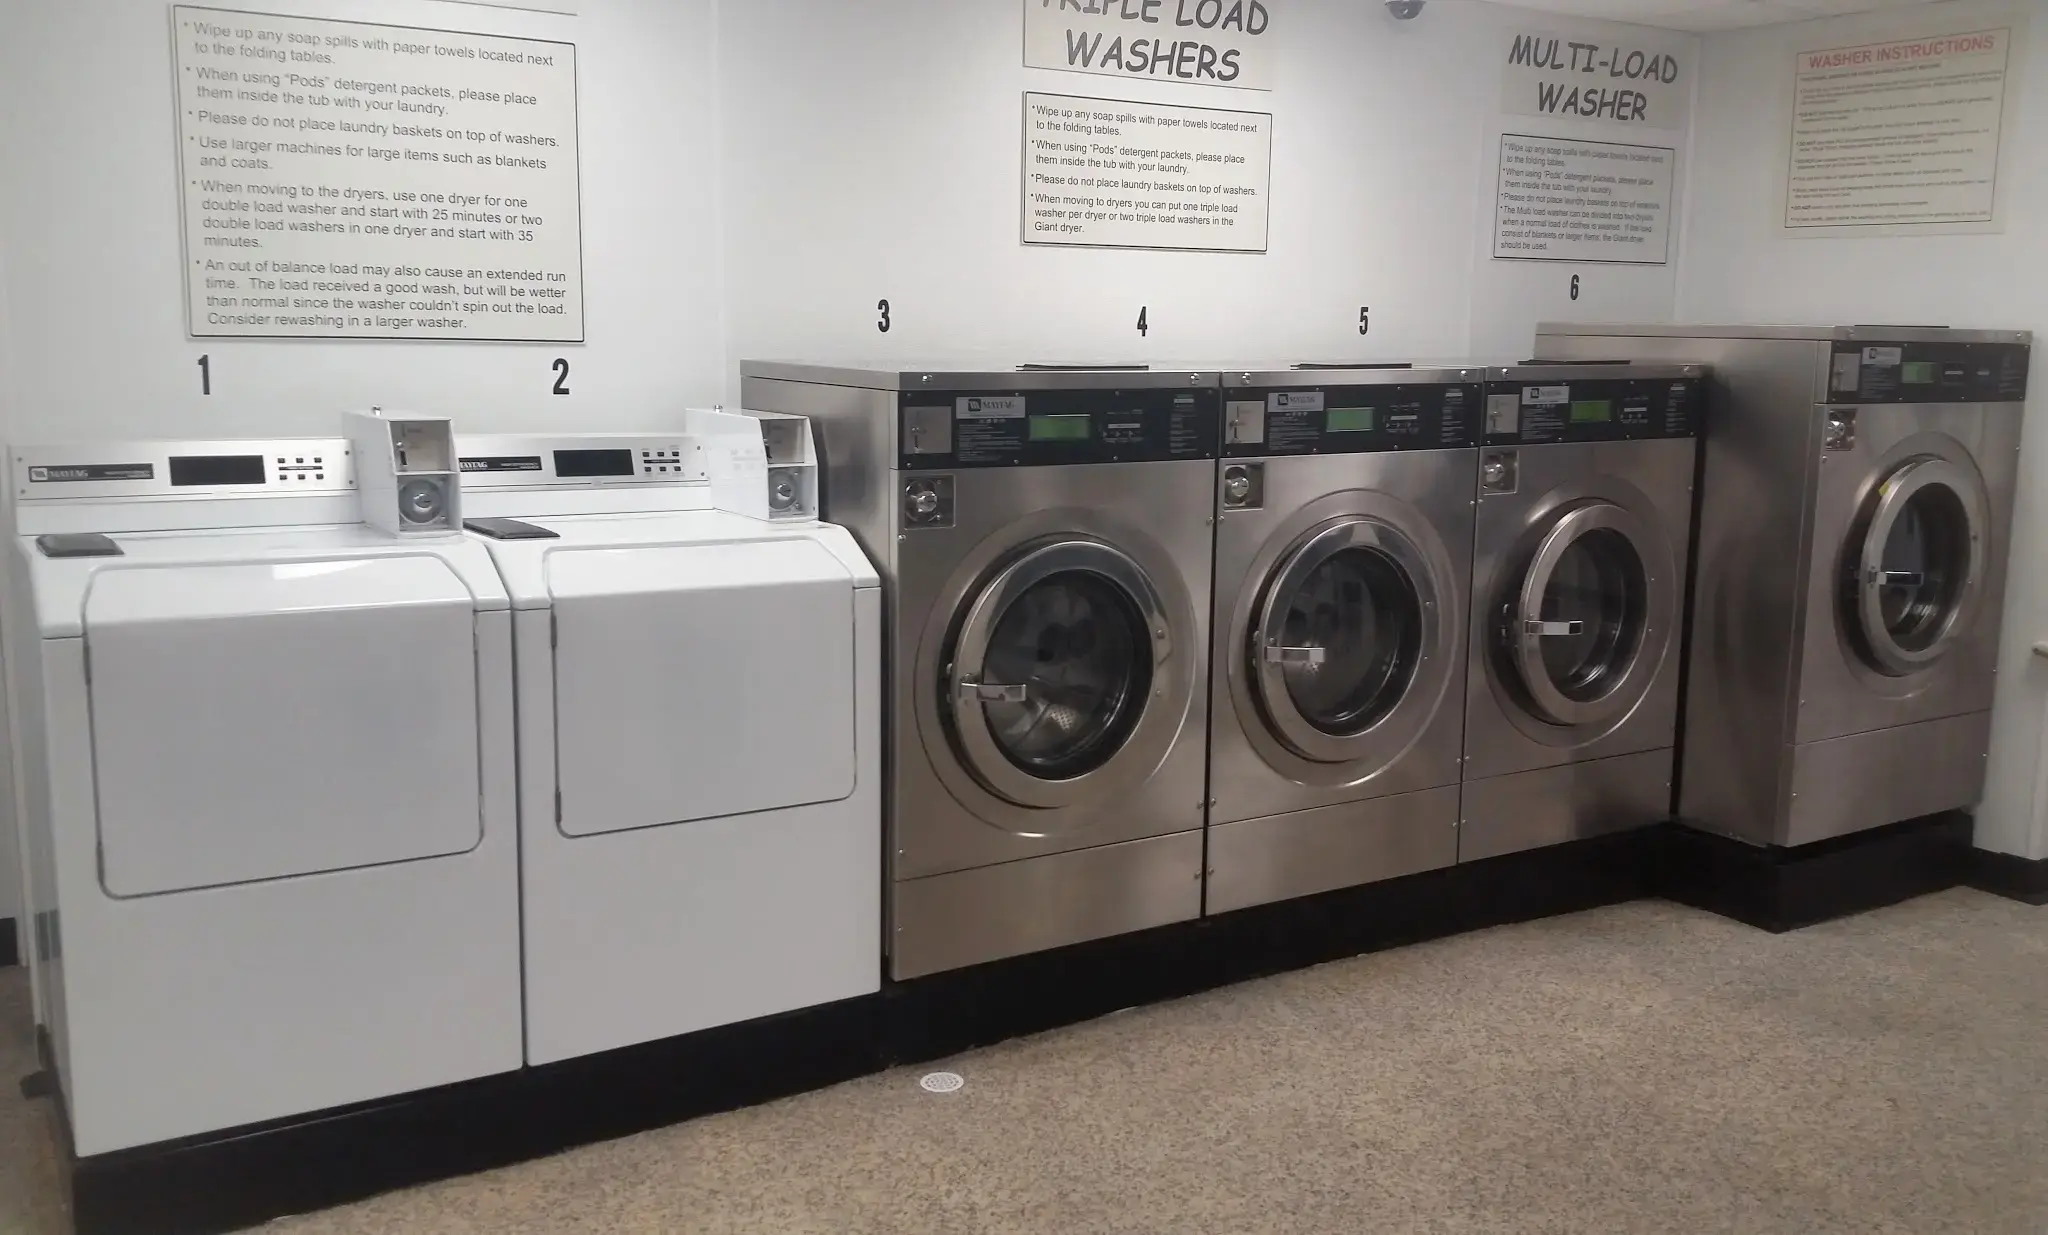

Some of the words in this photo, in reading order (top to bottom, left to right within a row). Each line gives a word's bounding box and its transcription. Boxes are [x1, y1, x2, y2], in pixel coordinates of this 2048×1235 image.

[1175, 0, 1269, 35] LOAD
[1066, 29, 1241, 82] WASHERS
[1508, 34, 1678, 84] MULTI-LOAD
[1808, 50, 1872, 68] WASHER
[1876, 35, 1996, 62] INSTRUCTIONS
[196, 66, 238, 81] When
[242, 73, 280, 88] using
[334, 77, 397, 95] detergent
[401, 84, 455, 98] packets,
[458, 87, 500, 102] please
[504, 92, 537, 105] place
[1538, 81, 1647, 121] WASHER
[198, 110, 247, 125] Please
[251, 115, 269, 127] do
[273, 117, 295, 128] not
[299, 117, 336, 131] place
[339, 120, 387, 137] laundry
[392, 123, 442, 138] baskets
[446, 129, 462, 139] on
[466, 129, 486, 143] top
[489, 130, 501, 142] of
[504, 133, 561, 147] washers.
[1036, 104, 1059, 118] Wipe
[1061, 109, 1073, 119] up
[1074, 110, 1091, 121] any
[1092, 112, 1114, 122] soap
[1115, 112, 1137, 124] spills
[1138, 114, 1155, 124] with
[1157, 117, 1180, 128] paper
[1182, 118, 1208, 129] towels
[1210, 120, 1239, 132] located
[1240, 124, 1257, 133] next
[1036, 119, 1045, 130] to
[1047, 120, 1061, 131] the
[1063, 121, 1092, 136] folding
[1094, 124, 1122, 136] tables.
[1035, 139, 1062, 151] When
[1063, 142, 1087, 155] using
[1119, 146, 1159, 159] detergent
[1160, 149, 1194, 161] packets,
[1195, 151, 1222, 163] please
[1223, 153, 1245, 164] place
[1035, 153, 1058, 165] them
[1059, 155, 1085, 167] inside
[1087, 157, 1101, 168] the
[1103, 159, 1117, 169] tub
[1118, 160, 1135, 170] with
[1137, 163, 1155, 173] your
[1157, 162, 1190, 176] laundry.
[201, 179, 242, 193] When
[247, 184, 297, 199] moving
[301, 185, 314, 197] to
[318, 185, 339, 198] the
[343, 186, 390, 202] dryers,
[392, 192, 416, 202] use
[420, 193, 444, 203] one
[448, 192, 480, 207] dryer
[484, 194, 500, 206] for
[504, 198, 527, 208] one
[1035, 173, 1065, 185] Please
[1067, 175, 1079, 186] do
[1080, 177, 1094, 186] not
[1096, 177, 1119, 189] place
[1121, 178, 1152, 192] laundry
[1153, 180, 1185, 192] baskets
[1186, 184, 1197, 192] on
[1198, 184, 1212, 194] top
[1213, 184, 1221, 194] of
[1222, 185, 1258, 196] washers.
[1034, 208, 1066, 218] washer
[1068, 211, 1082, 221] per
[1084, 210, 1106, 222] dryer
[1108, 213, 1117, 221] or
[1119, 212, 1134, 222] two
[1136, 212, 1156, 224] triple
[1158, 213, 1175, 224] load
[1177, 215, 1210, 225] washers
[1212, 215, 1220, 225] in
[1221, 217, 1234, 226] the
[1035, 193, 1061, 204] When
[1062, 195, 1094, 208] moving
[1096, 197, 1104, 206] to
[1106, 197, 1132, 209] dryers
[1134, 200, 1150, 210] you
[1151, 201, 1166, 209] can
[1168, 201, 1181, 212] put
[1182, 203, 1198, 211] one
[1200, 202, 1219, 214] triple
[1221, 203, 1238, 213] load
[203, 217, 250, 229] double
[254, 218, 284, 231] load
[288, 220, 345, 233] washers
[349, 224, 360, 233] in
[364, 225, 389, 235] one
[393, 224, 425, 239] dryer
[430, 226, 454, 238] and
[458, 228, 486, 239] start
[489, 229, 514, 240] with
[518, 229, 533, 242] 35
[1034, 221, 1058, 232] Giant
[1060, 222, 1085, 235] dryer.
[206, 258, 223, 270] An
[228, 261, 250, 272] out
[255, 260, 268, 272] of
[272, 260, 325, 274] balance
[329, 262, 358, 275] load
[362, 265, 390, 278] may
[394, 265, 421, 277] also
[424, 268, 463, 278] cause
[467, 269, 482, 278] an
[486, 269, 543, 281] extended
[546, 272, 566, 282] run
[1569, 274, 1580, 301] 6
[207, 296, 237, 307] than
[242, 296, 289, 308] normal
[293, 298, 328, 308] since
[333, 297, 353, 309] the
[357, 298, 404, 310] washer
[462, 300, 488, 314] spin
[492, 302, 511, 313] out
[515, 302, 534, 314] the
[537, 302, 568, 314] load.
[877, 299, 890, 333] 3
[208, 312, 268, 325] Consider
[275, 314, 343, 329] rewashing
[348, 317, 359, 326] in
[363, 317, 371, 326] a
[376, 315, 412, 330] larger
[417, 317, 467, 328] washer.
[1136, 306, 1148, 337] 4
[1358, 306, 1369, 336] 5
[197, 354, 211, 396] 1
[551, 358, 570, 395] 2
